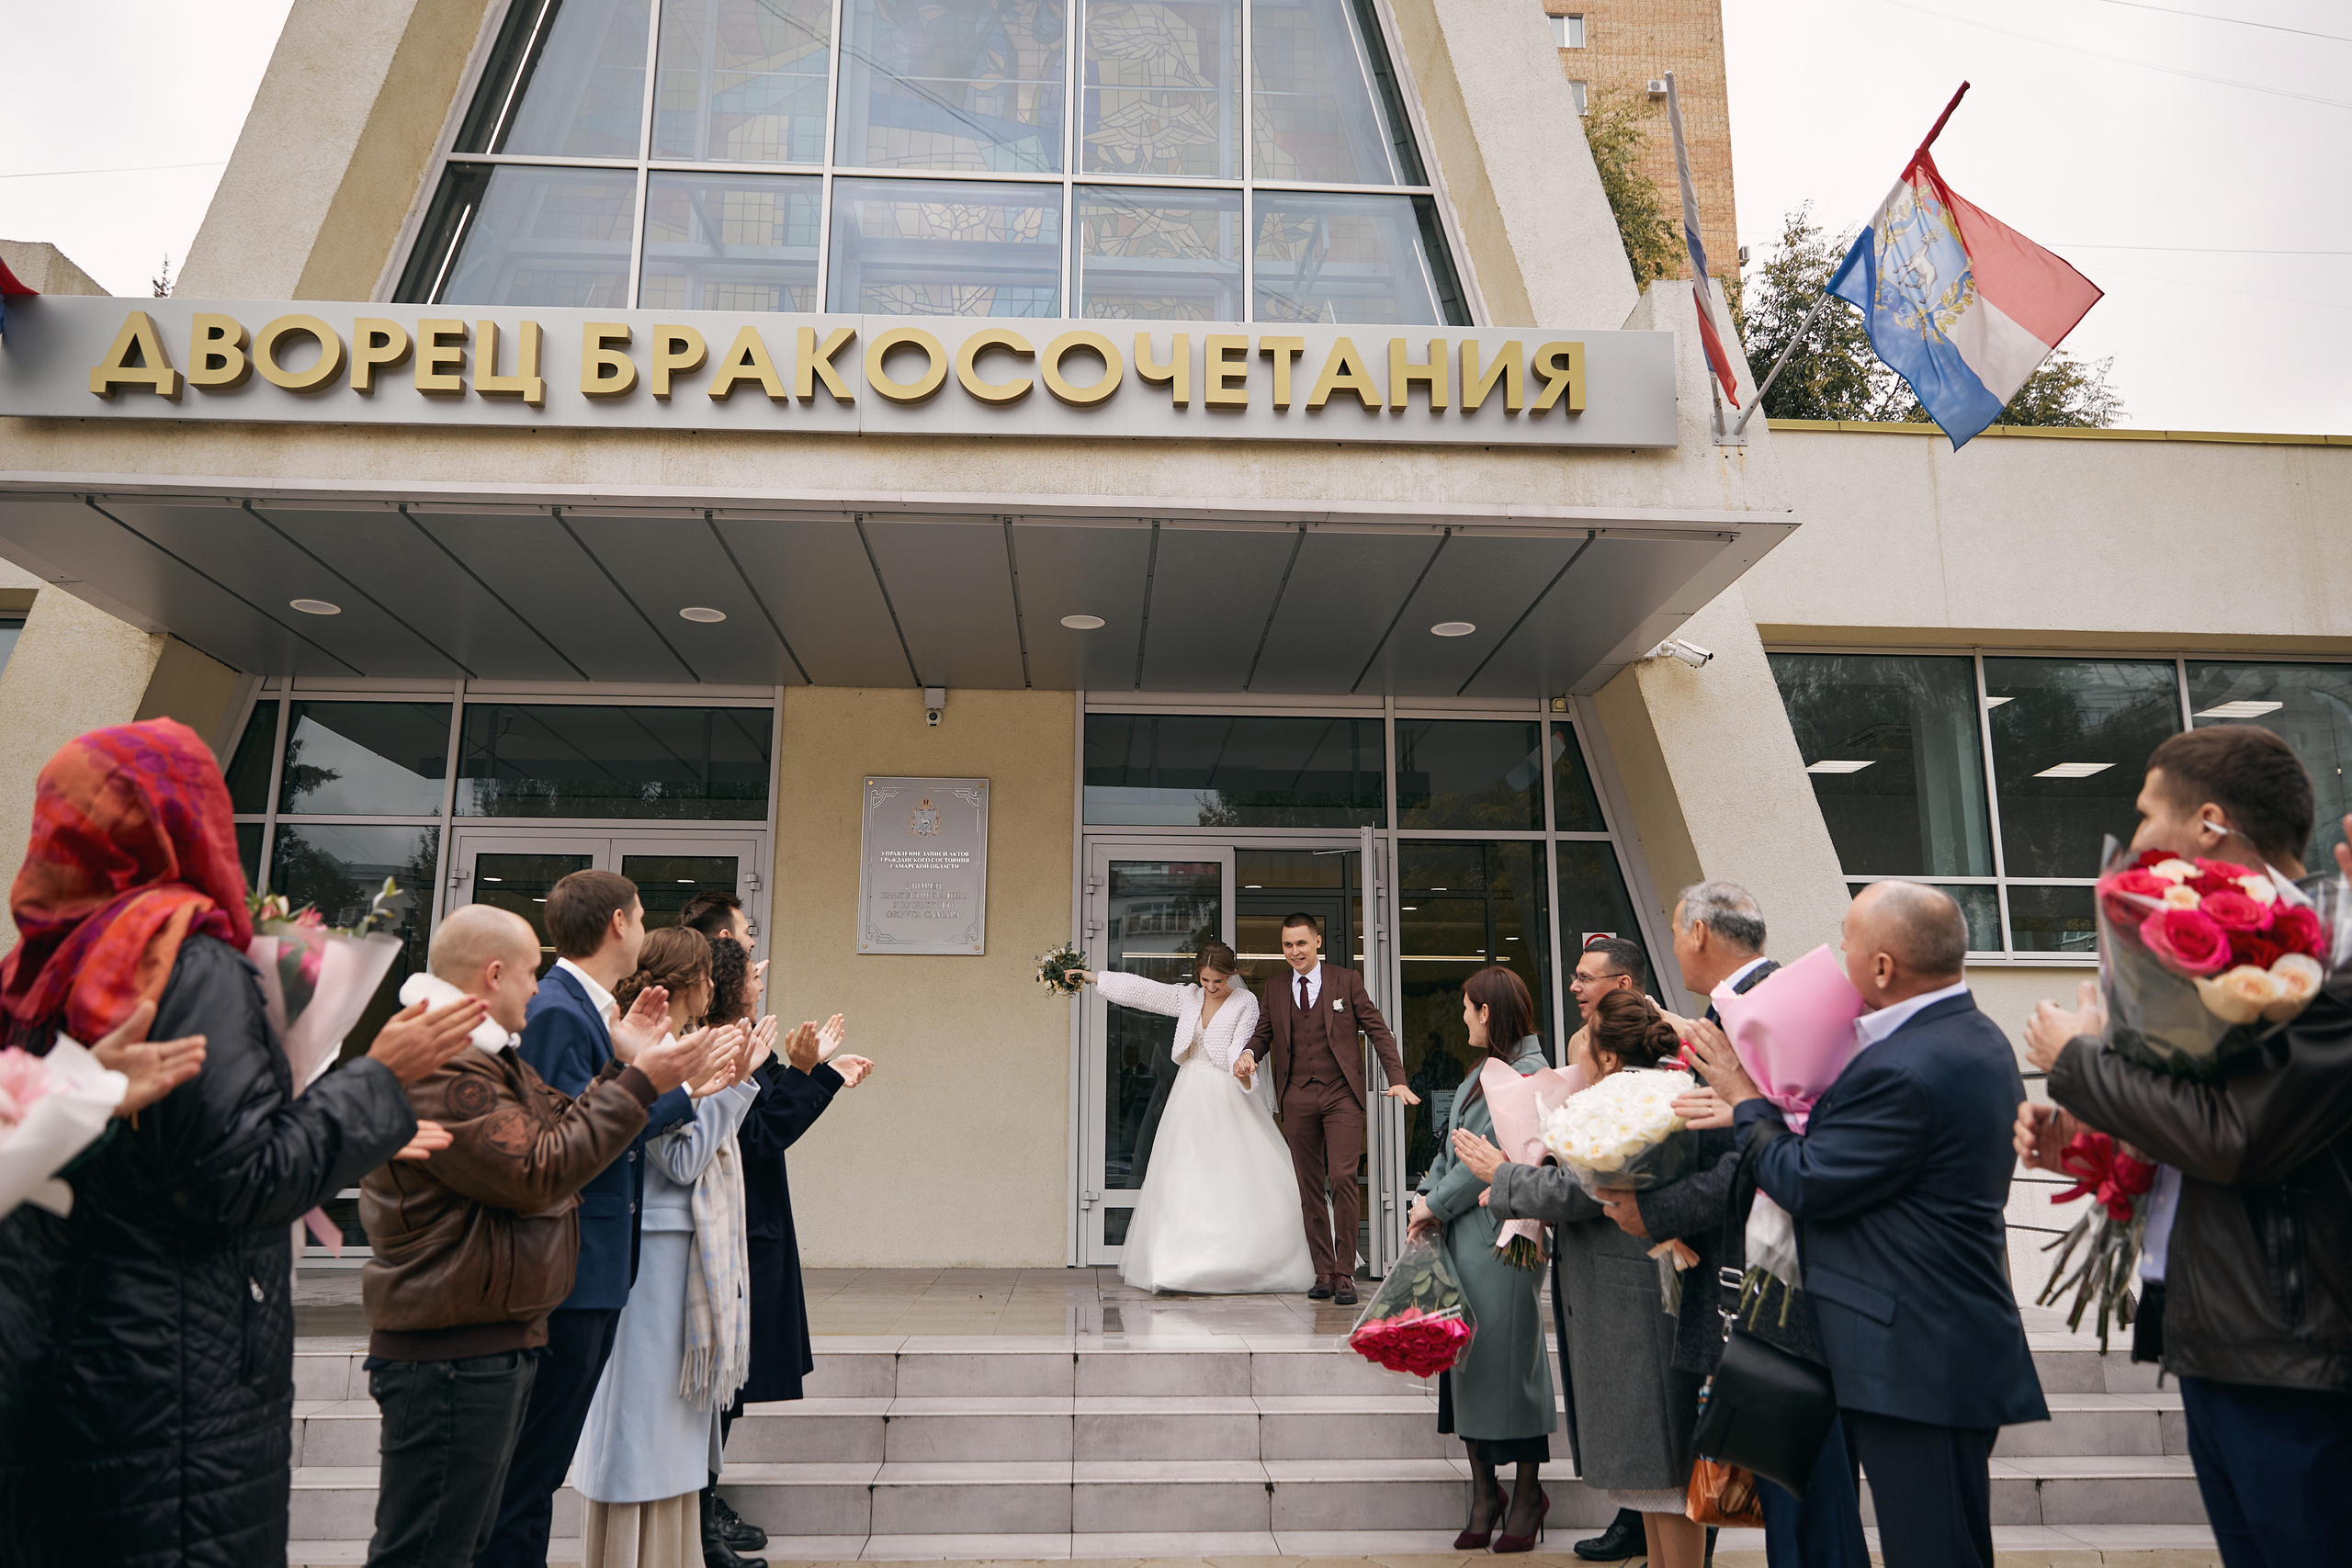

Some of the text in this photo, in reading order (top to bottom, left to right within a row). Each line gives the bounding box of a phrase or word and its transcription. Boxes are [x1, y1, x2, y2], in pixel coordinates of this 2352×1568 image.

[88, 310, 1586, 415] ДВОРЕЦ БРАКОСОЧЕТАНИЯ
[905, 882, 943, 891] ДВОРЕЦ
[924, 910, 962, 919] САМАРА
